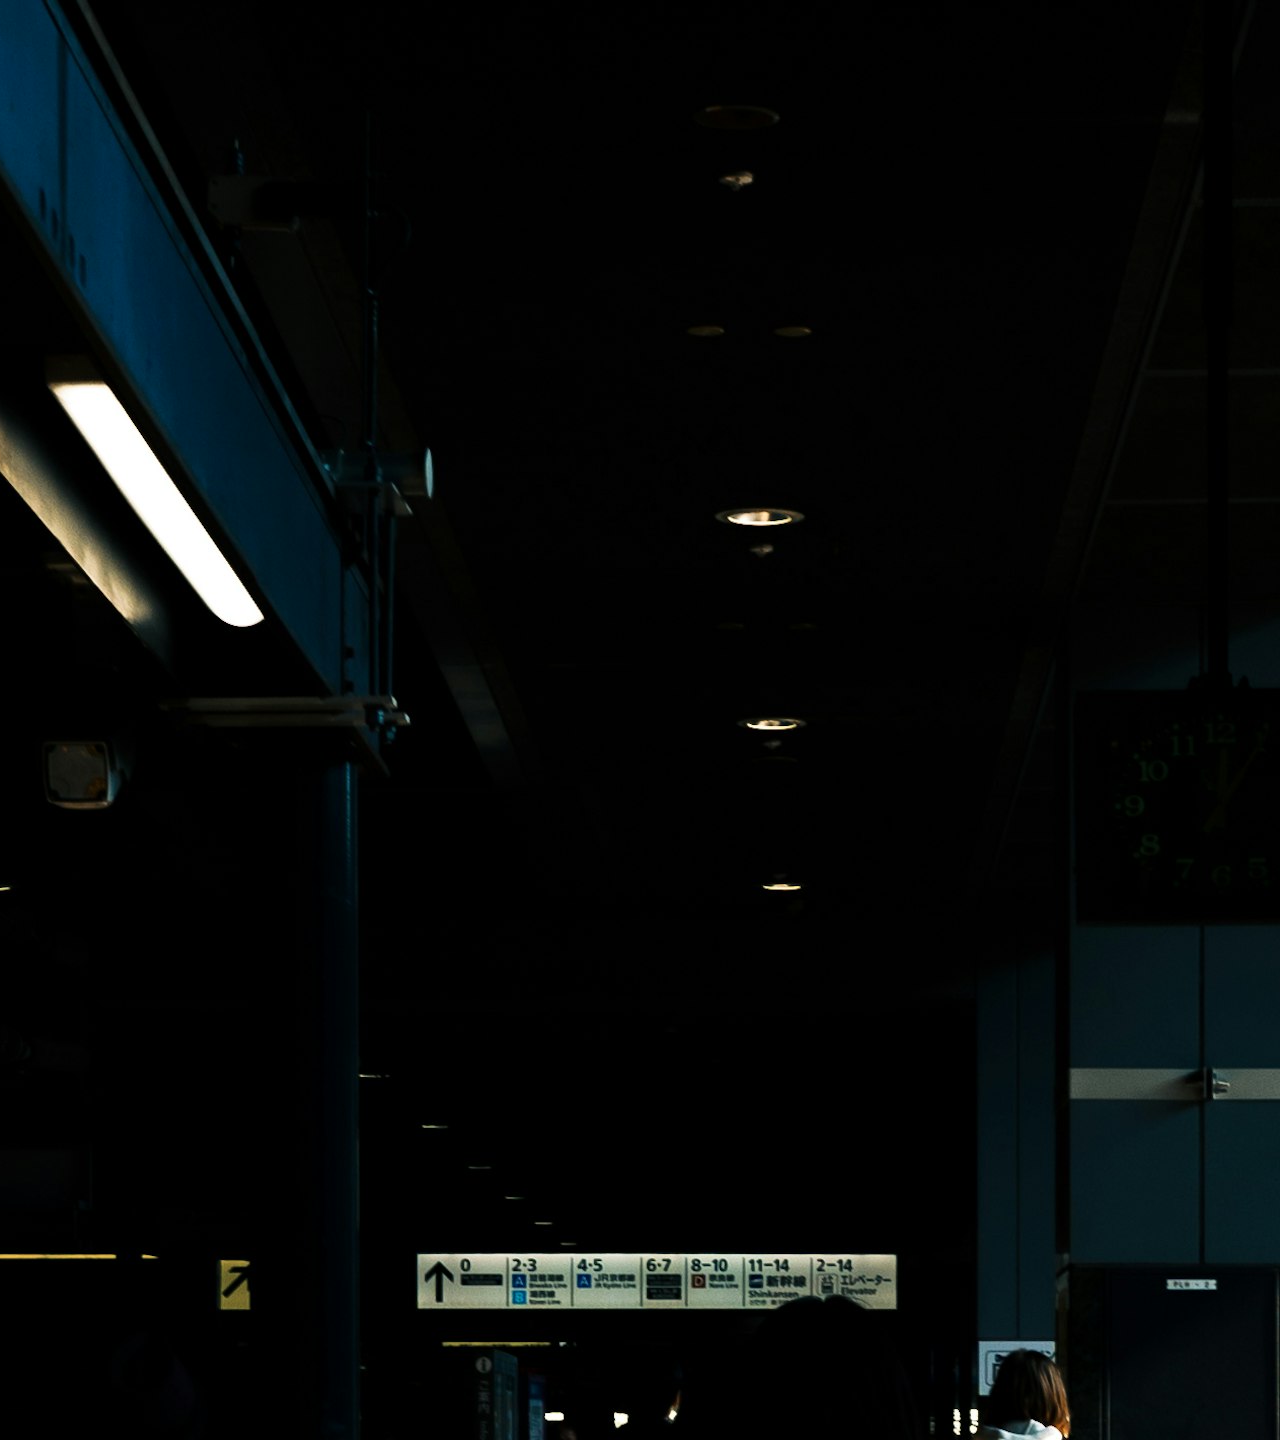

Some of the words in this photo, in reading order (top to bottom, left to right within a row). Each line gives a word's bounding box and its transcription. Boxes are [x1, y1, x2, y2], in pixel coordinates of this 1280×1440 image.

[461, 1259, 471, 1271] 0
[840, 1275, 892, 1285] エレベーター
